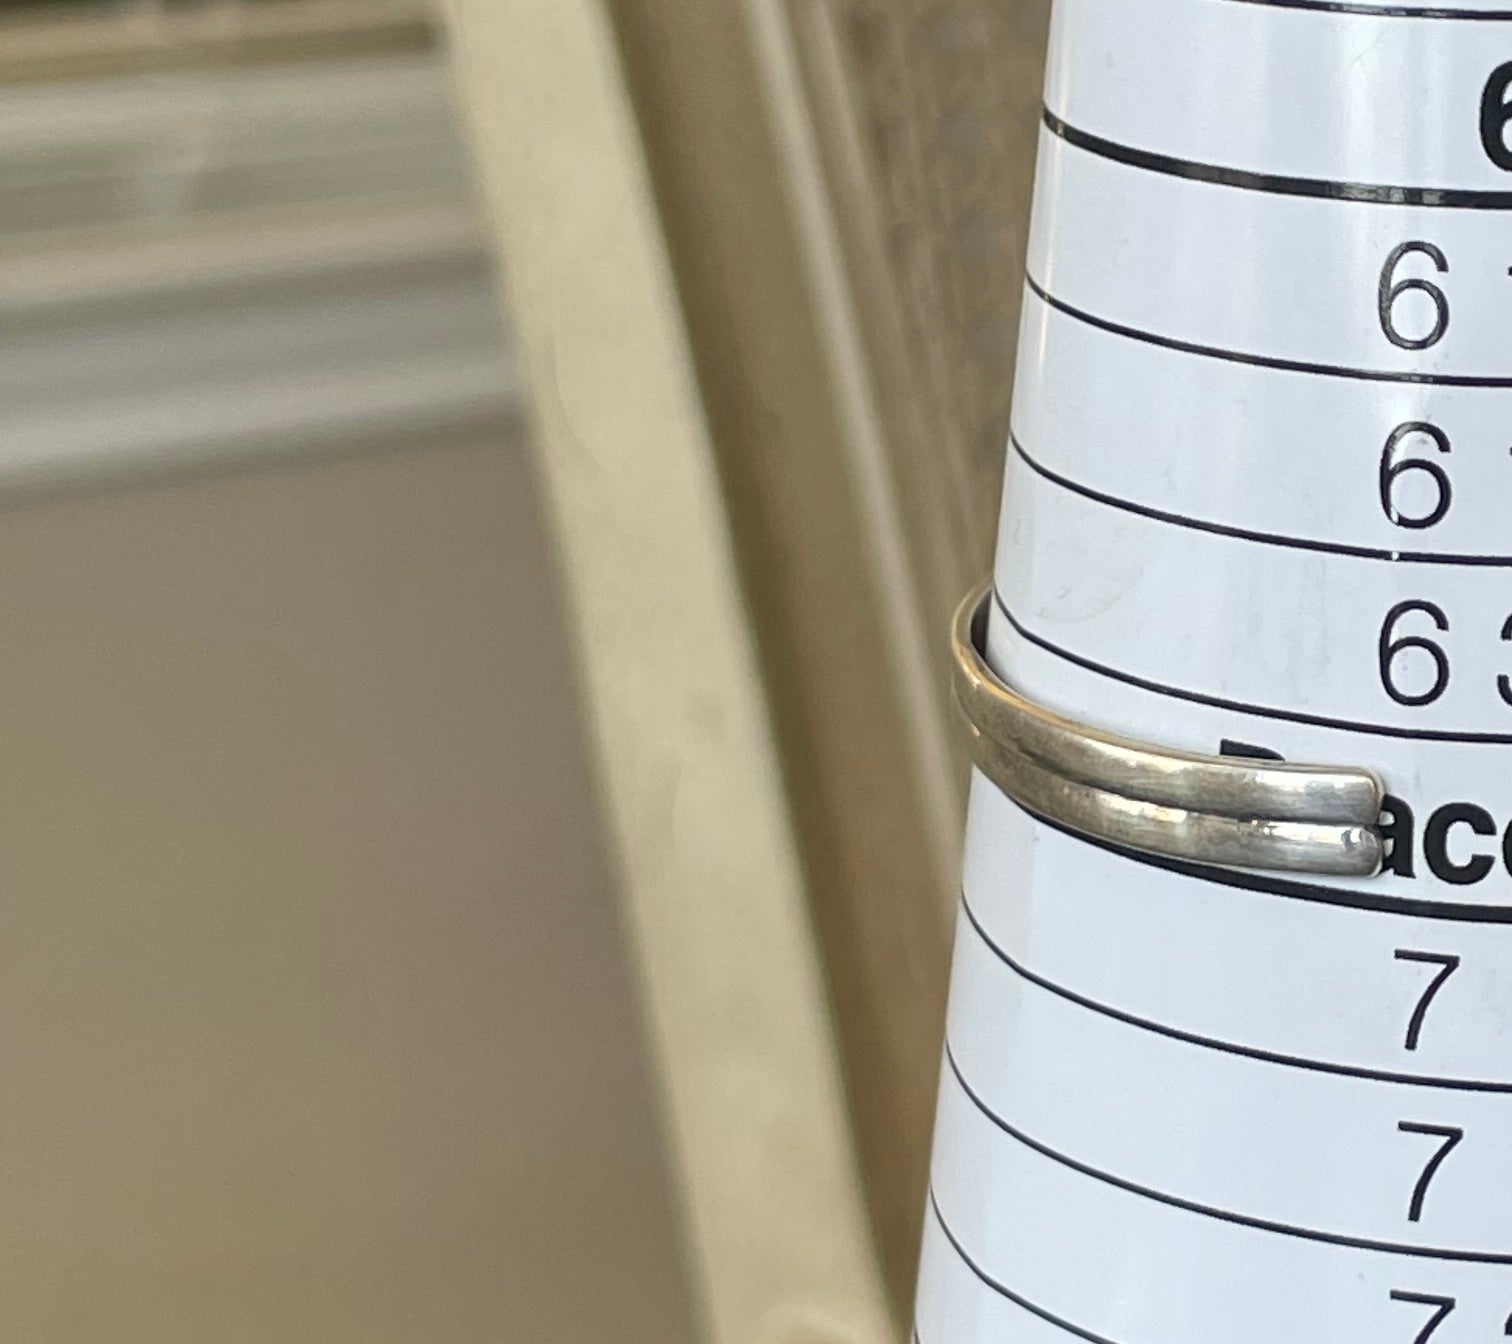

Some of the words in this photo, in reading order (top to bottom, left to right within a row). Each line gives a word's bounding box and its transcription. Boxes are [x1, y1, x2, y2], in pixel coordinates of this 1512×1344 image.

[1377, 240, 1450, 351] 6
[1378, 421, 1453, 530] 6
[1377, 599, 1451, 707] 6
[1393, 948, 1461, 1052] 7
[1397, 1120, 1464, 1223] 7
